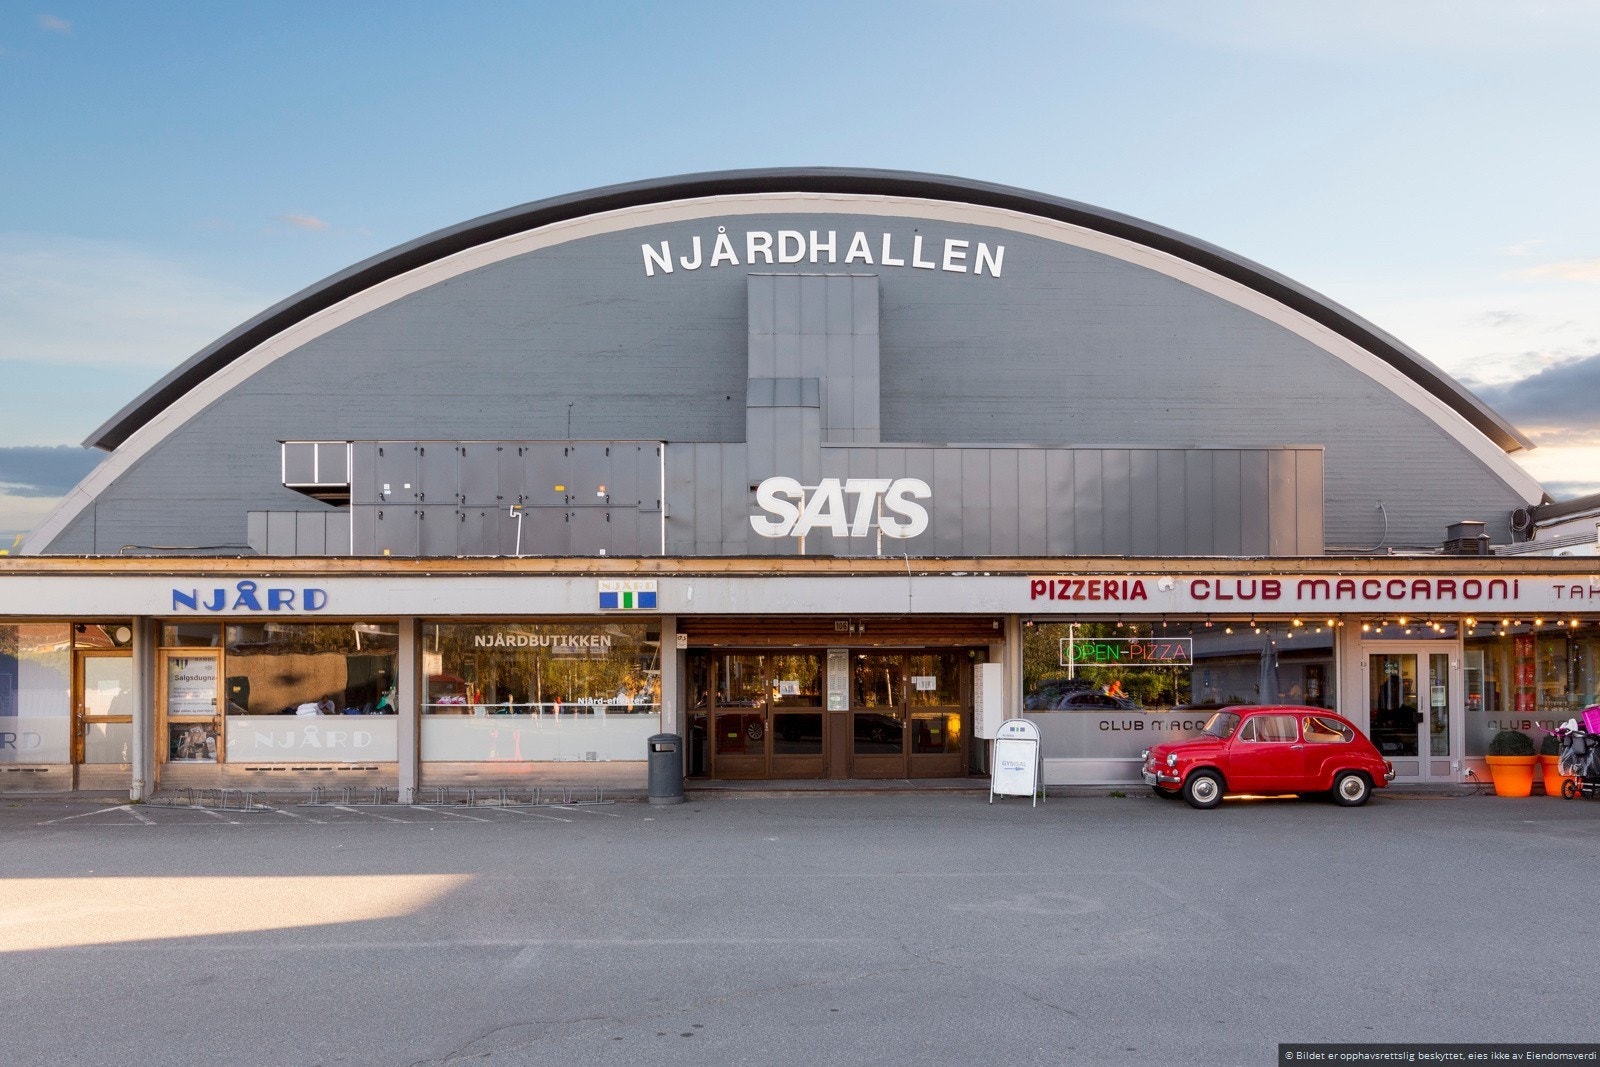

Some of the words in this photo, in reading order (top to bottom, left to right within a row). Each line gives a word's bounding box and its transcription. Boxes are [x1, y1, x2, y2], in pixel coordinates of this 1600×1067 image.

[641, 225, 1005, 278] NJÅRDHALLEN
[749, 476, 932, 539] SATS
[172, 580, 328, 611] NJÅRD
[1030, 579, 1147, 600] PIZZERIA
[1190, 579, 1282, 600] CLUB
[474, 633, 611, 647] NJÅRDBUTIKKEN
[1065, 644, 1187, 660] OPEN-PIZZA
[1099, 720, 1144, 731] CLUB
[1487, 720, 1532, 731] CLUB
[254, 725, 372, 748] NJÅRD
